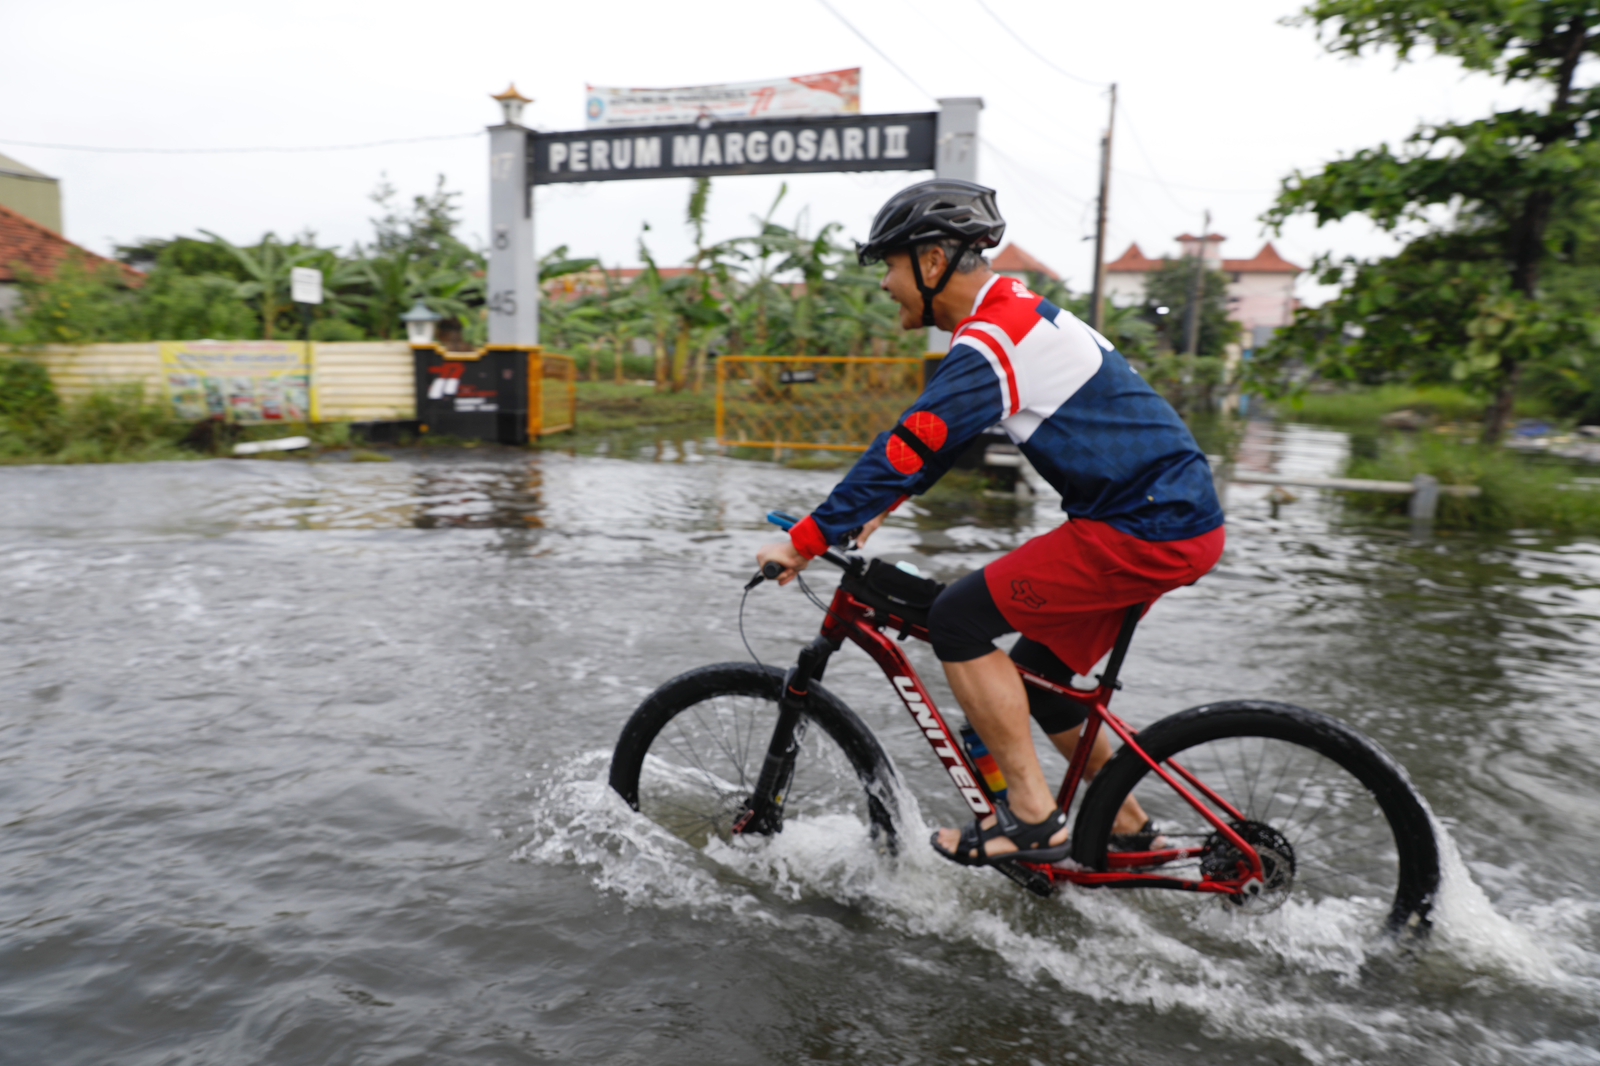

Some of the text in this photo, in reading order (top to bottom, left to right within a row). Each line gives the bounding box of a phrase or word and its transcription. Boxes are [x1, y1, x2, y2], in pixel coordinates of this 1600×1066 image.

[549, 136, 662, 173] PERUM
[672, 126, 880, 167] MARGOSARI
[892, 675, 992, 814] UNITED
